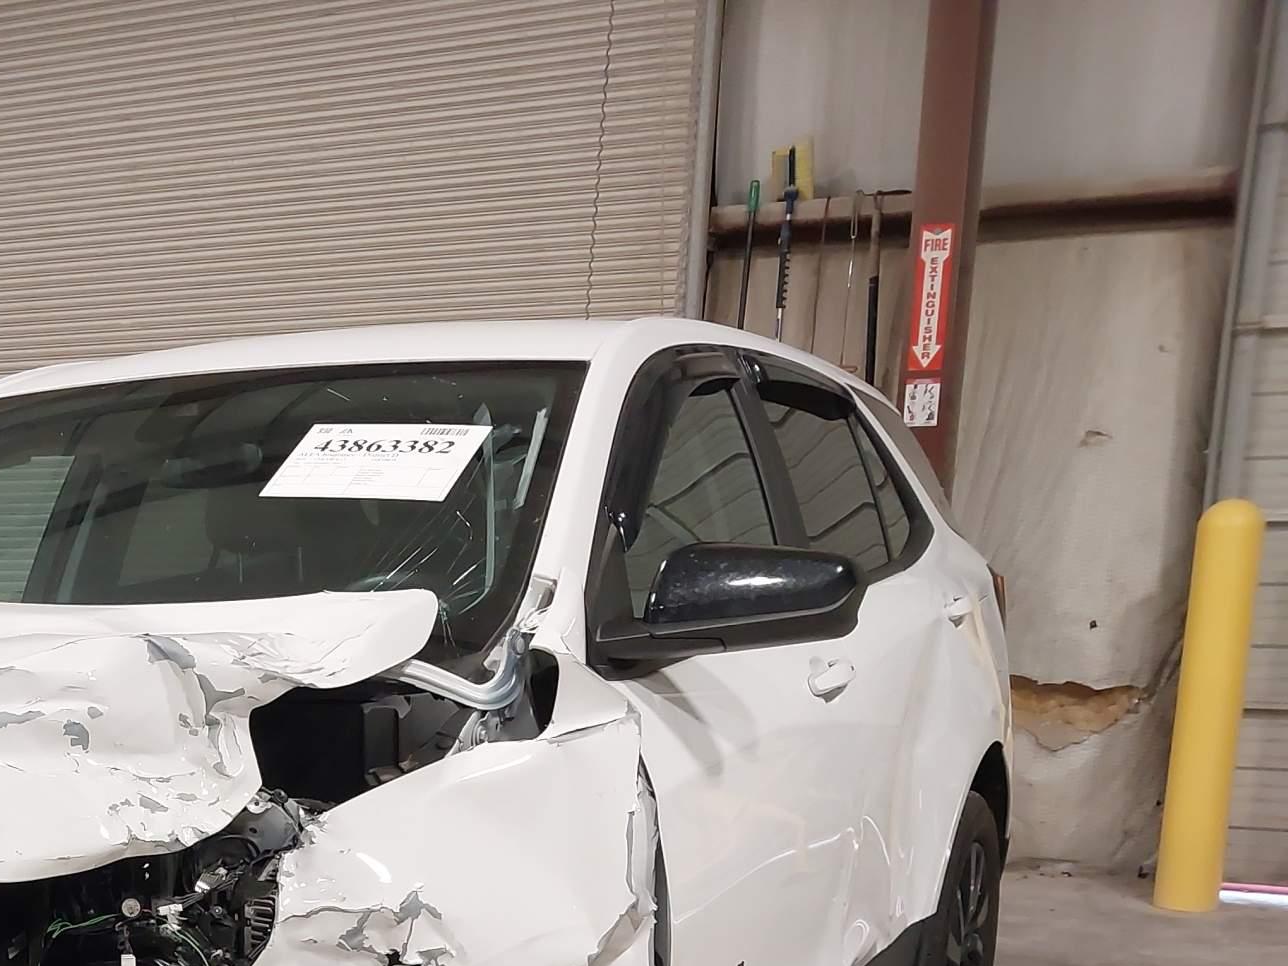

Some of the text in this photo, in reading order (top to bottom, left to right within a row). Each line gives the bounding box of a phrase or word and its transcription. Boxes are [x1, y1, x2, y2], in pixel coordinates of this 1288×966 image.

[923, 238, 949, 252] FIRE
[921, 257, 940, 360] EXTINGUISHER
[313, 438, 456, 454] 43863382
